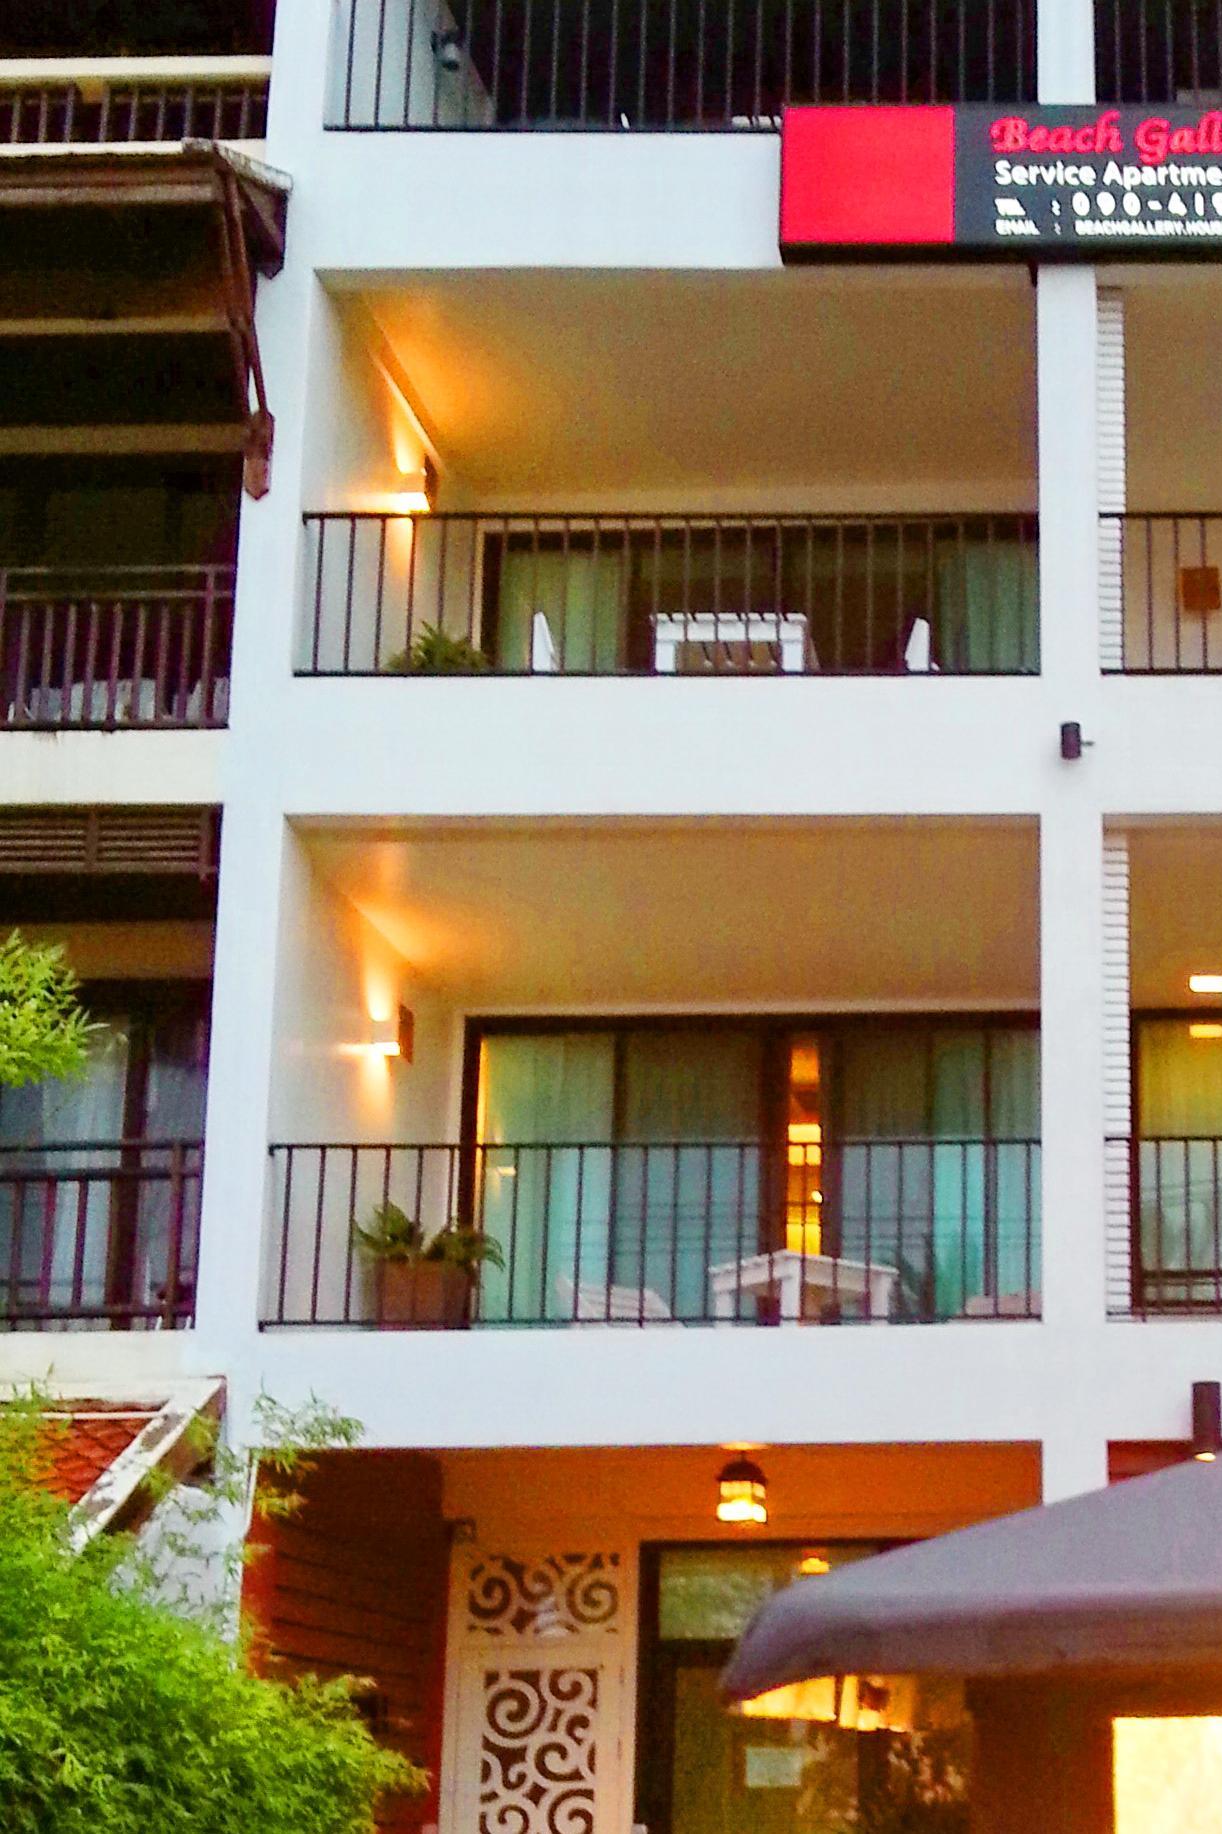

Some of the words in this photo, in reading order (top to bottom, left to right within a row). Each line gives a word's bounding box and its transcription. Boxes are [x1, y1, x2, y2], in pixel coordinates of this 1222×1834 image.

[989, 109, 1124, 153] Beach
[994, 159, 1097, 186] Service
[995, 219, 1041, 236] EMAIL
